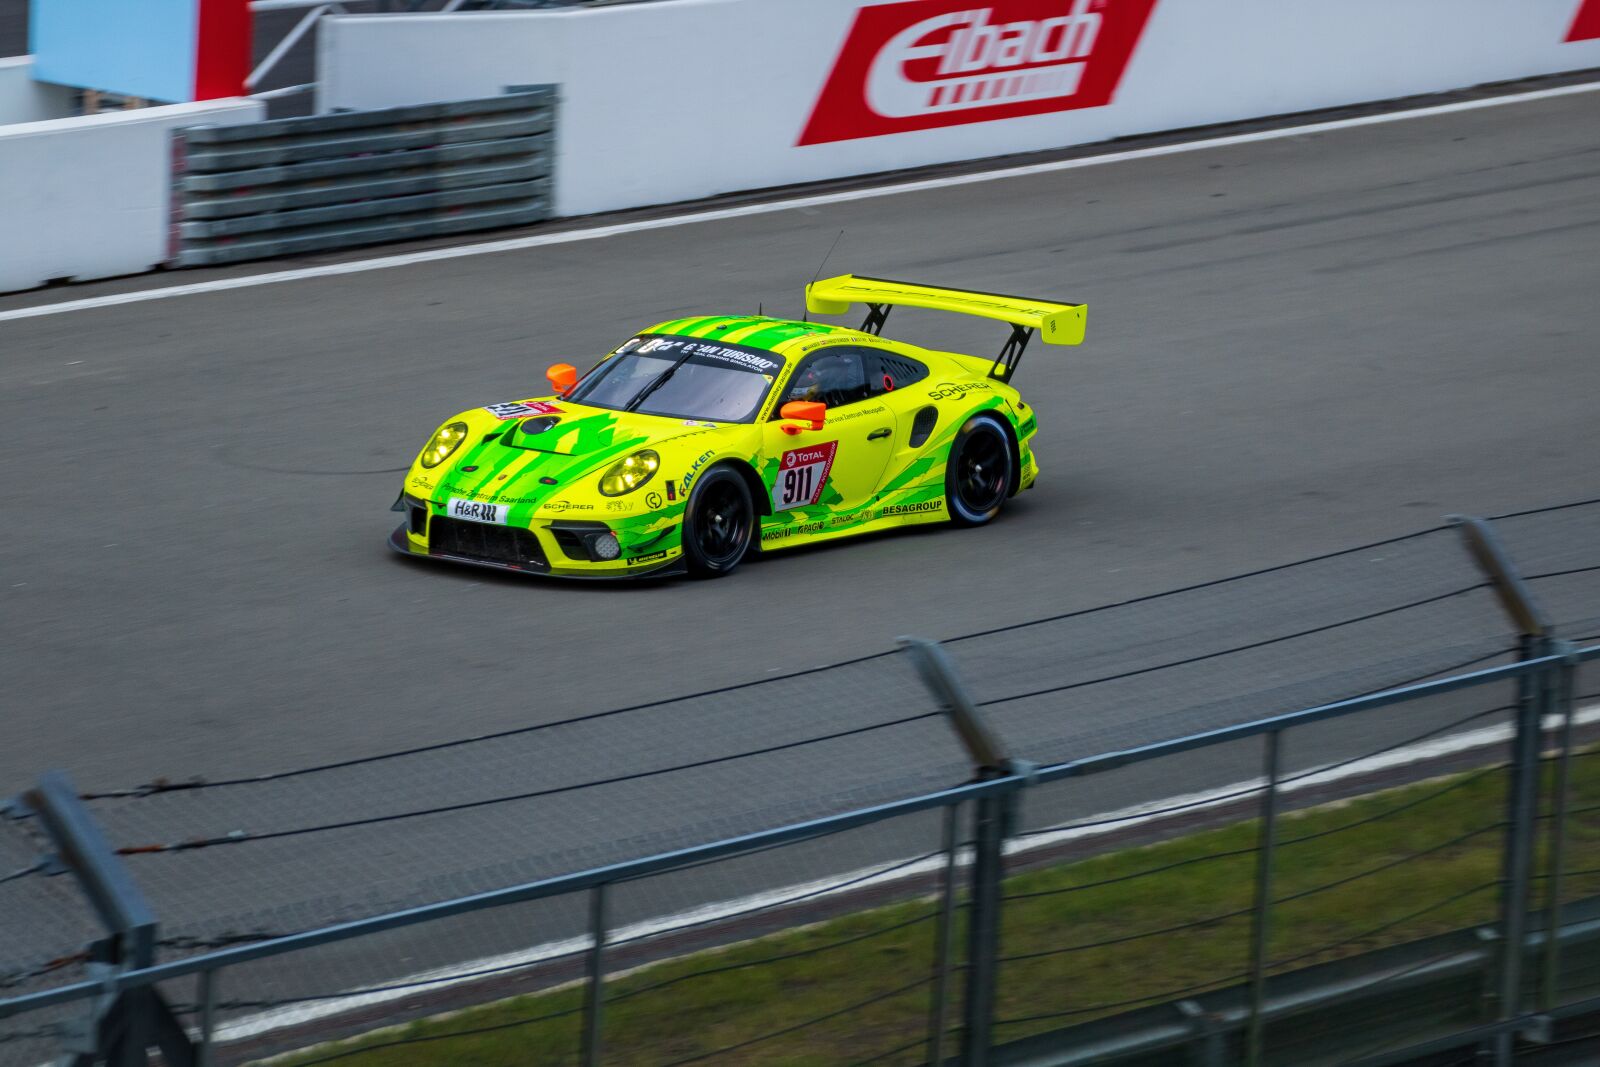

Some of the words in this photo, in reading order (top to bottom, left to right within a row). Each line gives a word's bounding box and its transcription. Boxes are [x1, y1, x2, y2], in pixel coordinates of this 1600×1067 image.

[717, 348, 774, 369] TURISMO
[797, 451, 824, 462] TOTAL
[783, 466, 813, 504] 911
[466, 490, 498, 501] Zentrum
[498, 495, 537, 504] Saarland
[455, 500, 480, 517] H&R
[543, 502, 594, 511] SCHERER
[882, 500, 942, 514] BESAGROUP
